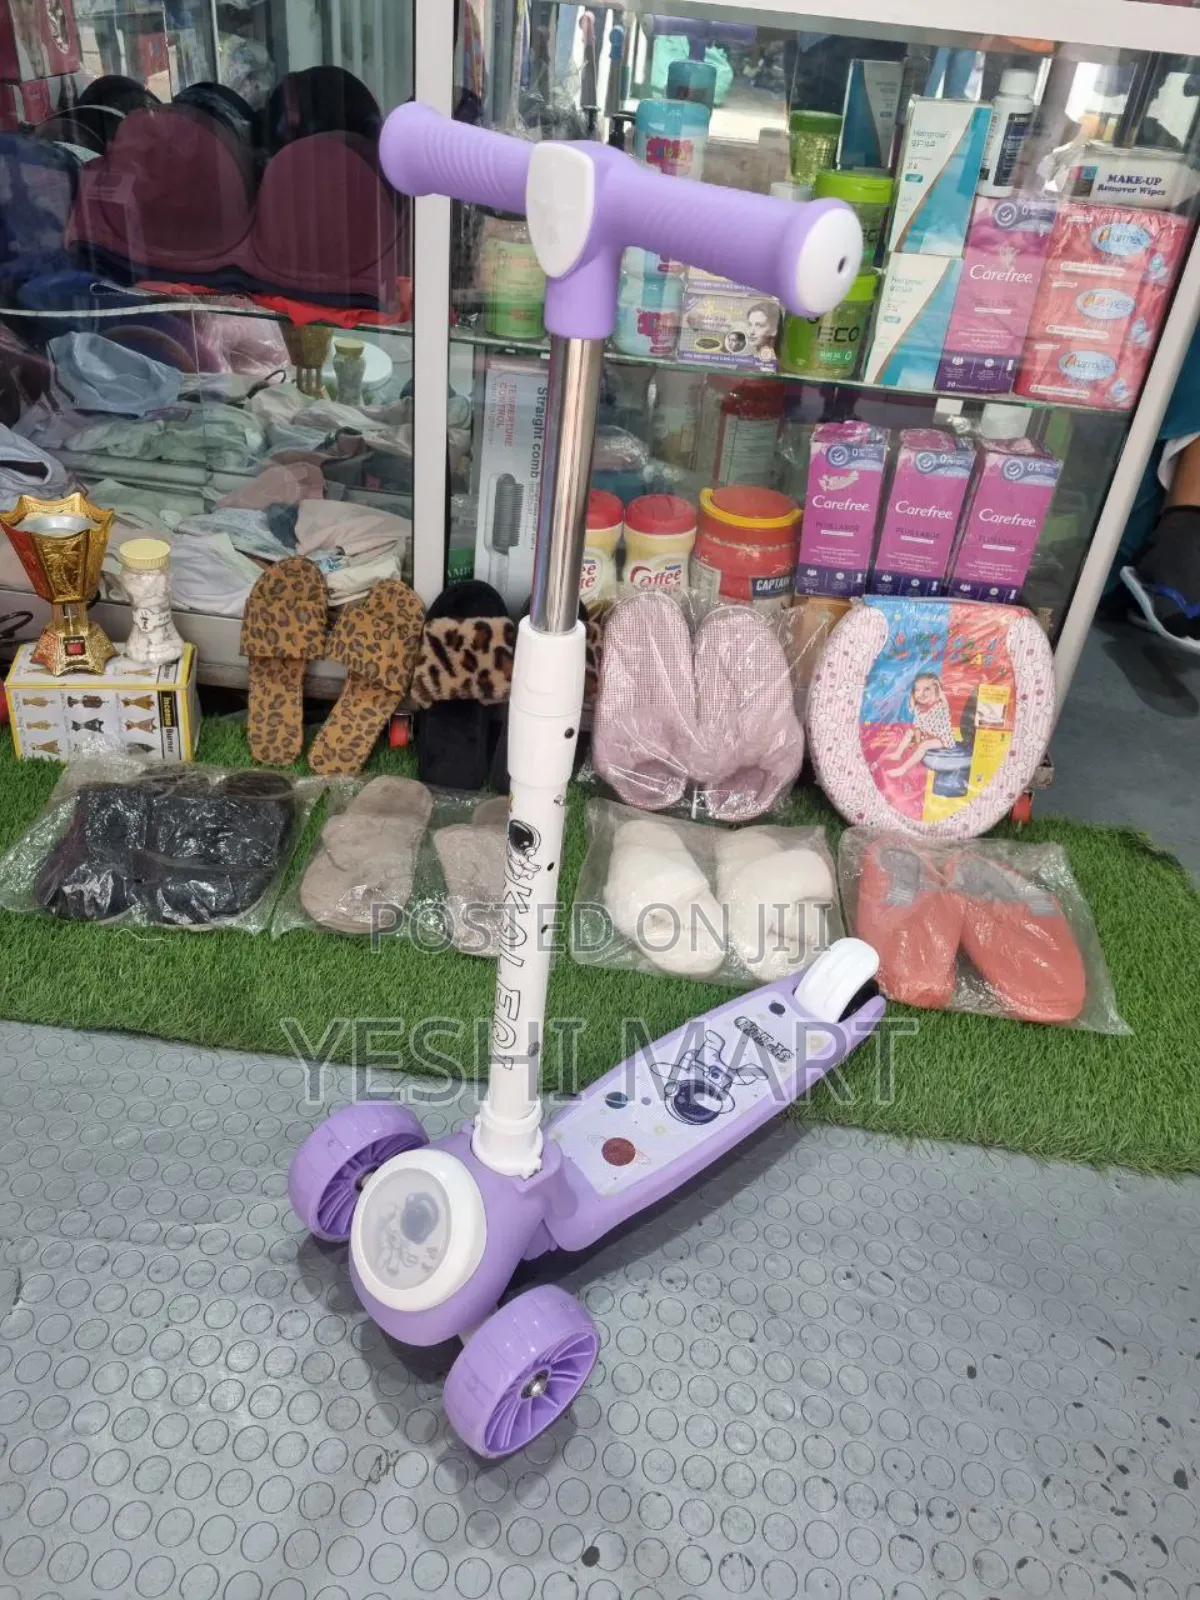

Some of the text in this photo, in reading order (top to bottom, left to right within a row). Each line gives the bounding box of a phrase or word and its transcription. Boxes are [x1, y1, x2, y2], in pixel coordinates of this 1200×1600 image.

[1107, 174, 1162, 186] MAKE-UP
[1097, 184, 1166, 197] Remover Wipes
[969, 264, 1033, 283] Carefree
[817, 325, 860, 343] ECO
[532, 386, 548, 440] Straight
[530, 444, 542, 479] comb
[812, 494, 870, 511] Carefree
[895, 500, 953, 520] Carefree
[979, 508, 1036, 528] Carefree
[165, 728, 174, 753] Burner
